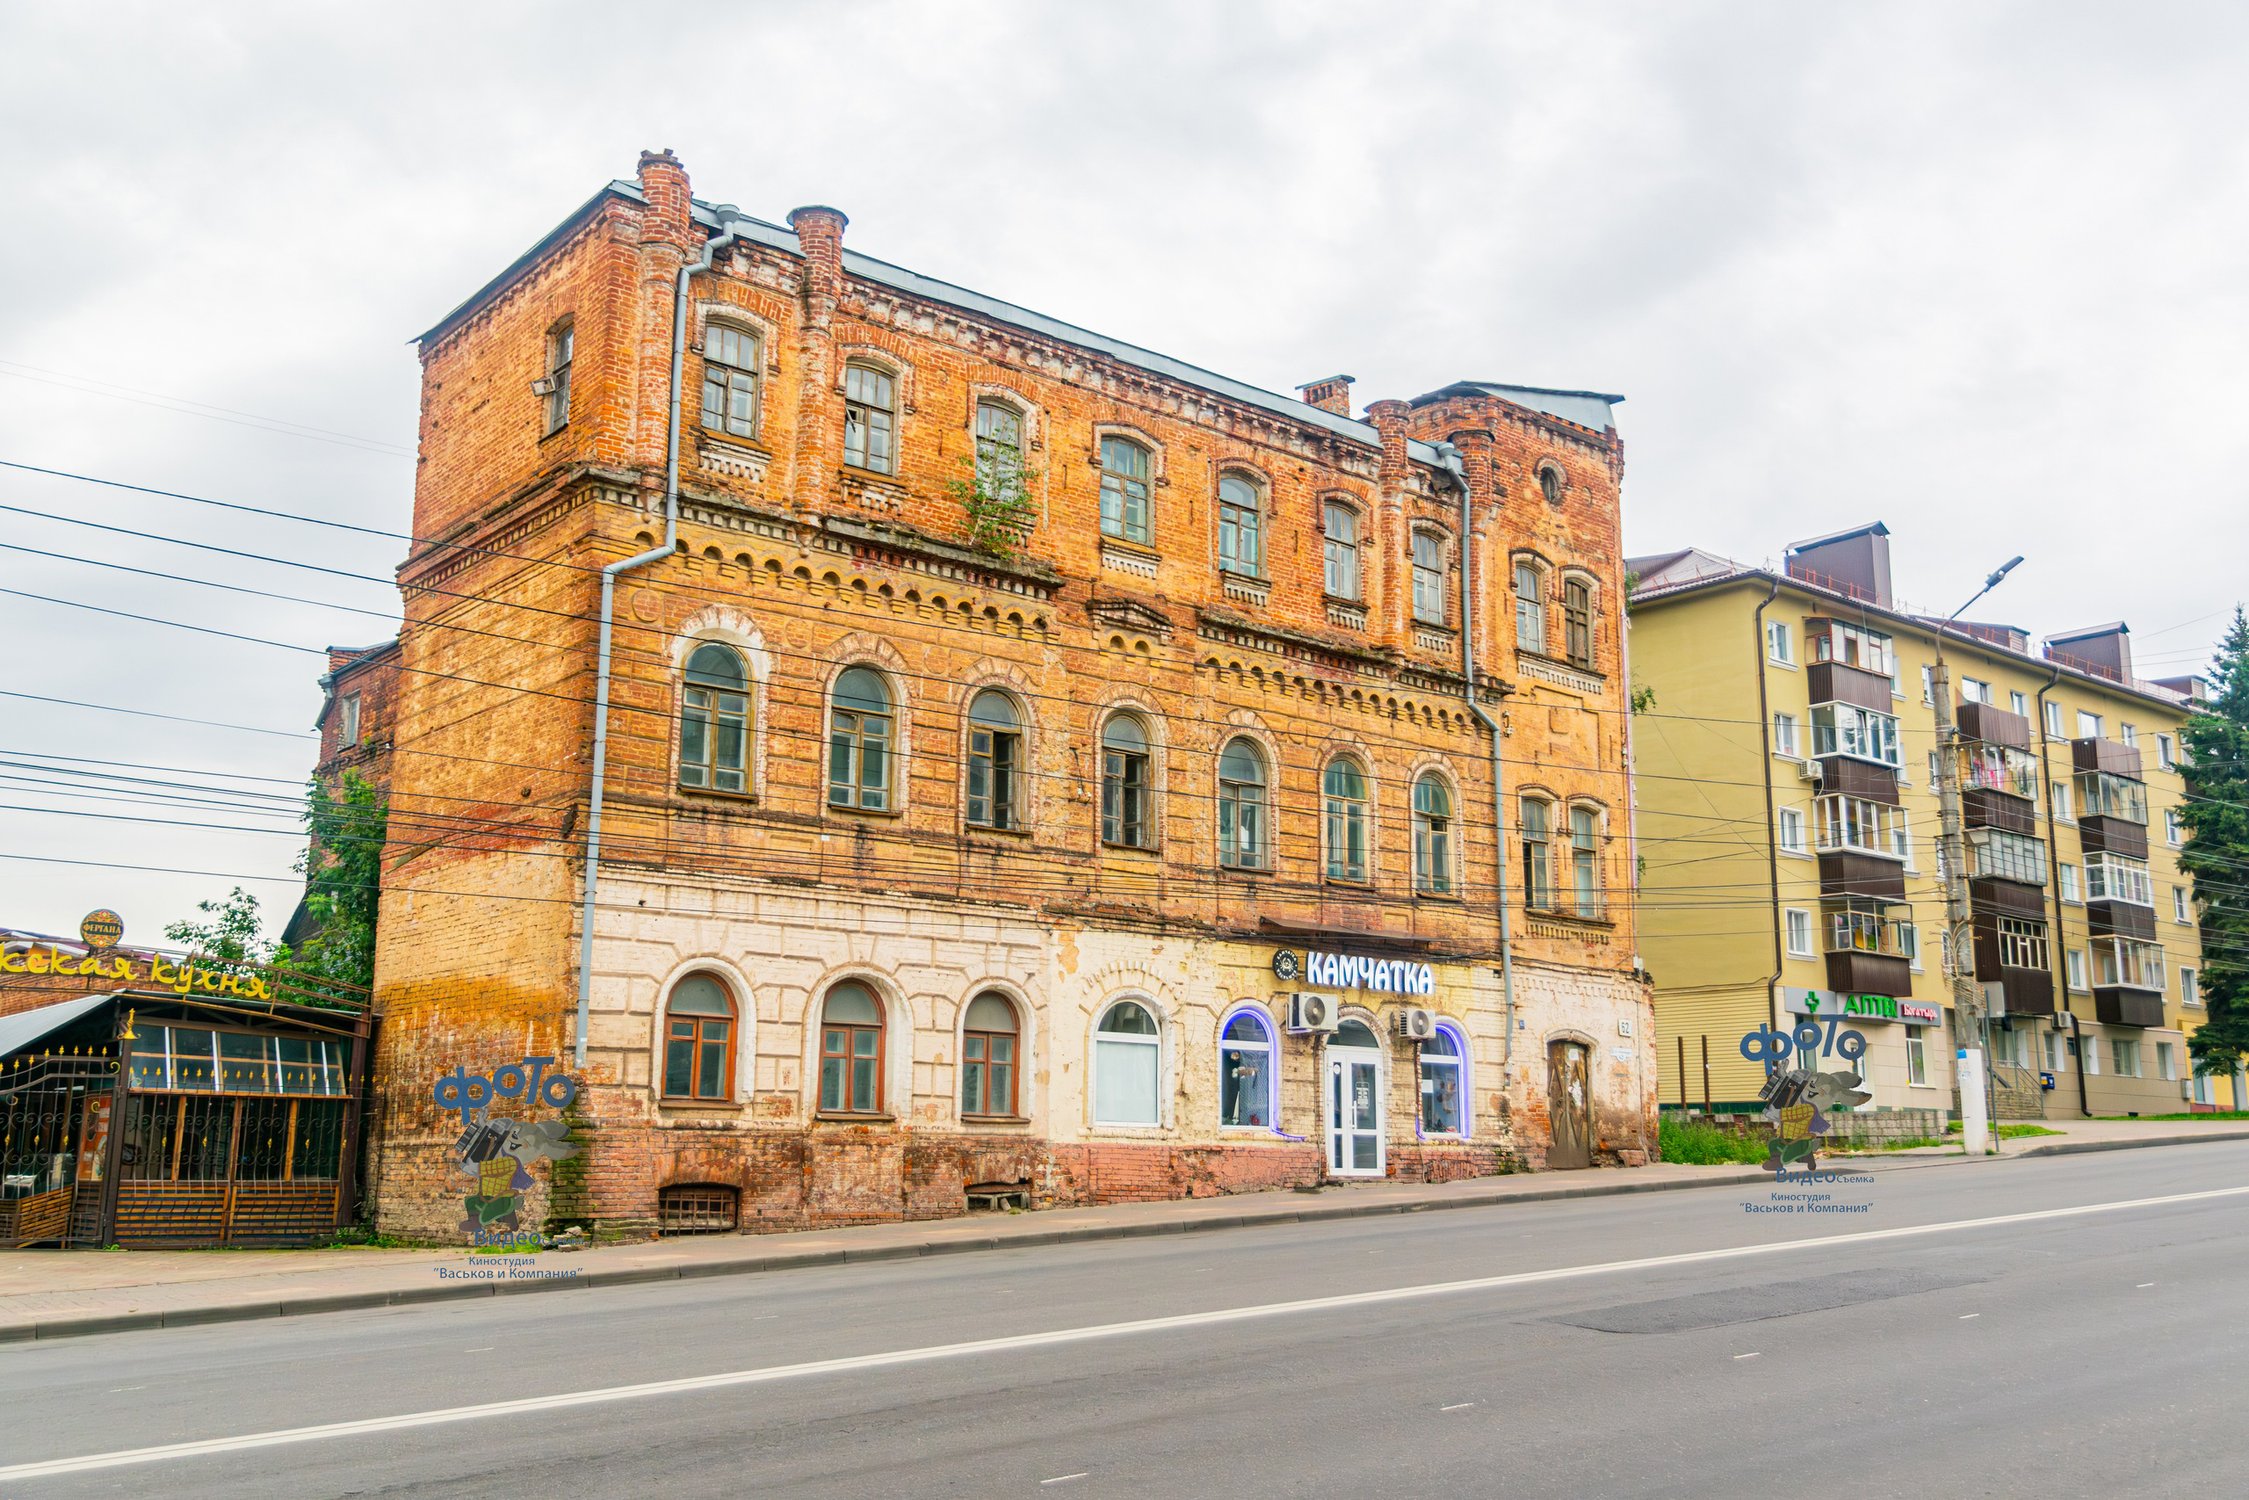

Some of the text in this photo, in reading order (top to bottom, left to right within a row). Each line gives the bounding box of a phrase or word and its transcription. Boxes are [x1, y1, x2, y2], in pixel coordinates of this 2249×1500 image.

[83, 923, 121, 934] ФЕРГАНА
[150, 953, 271, 1000] кухня
[1307, 951, 1433, 995] КАМЧАТКА
